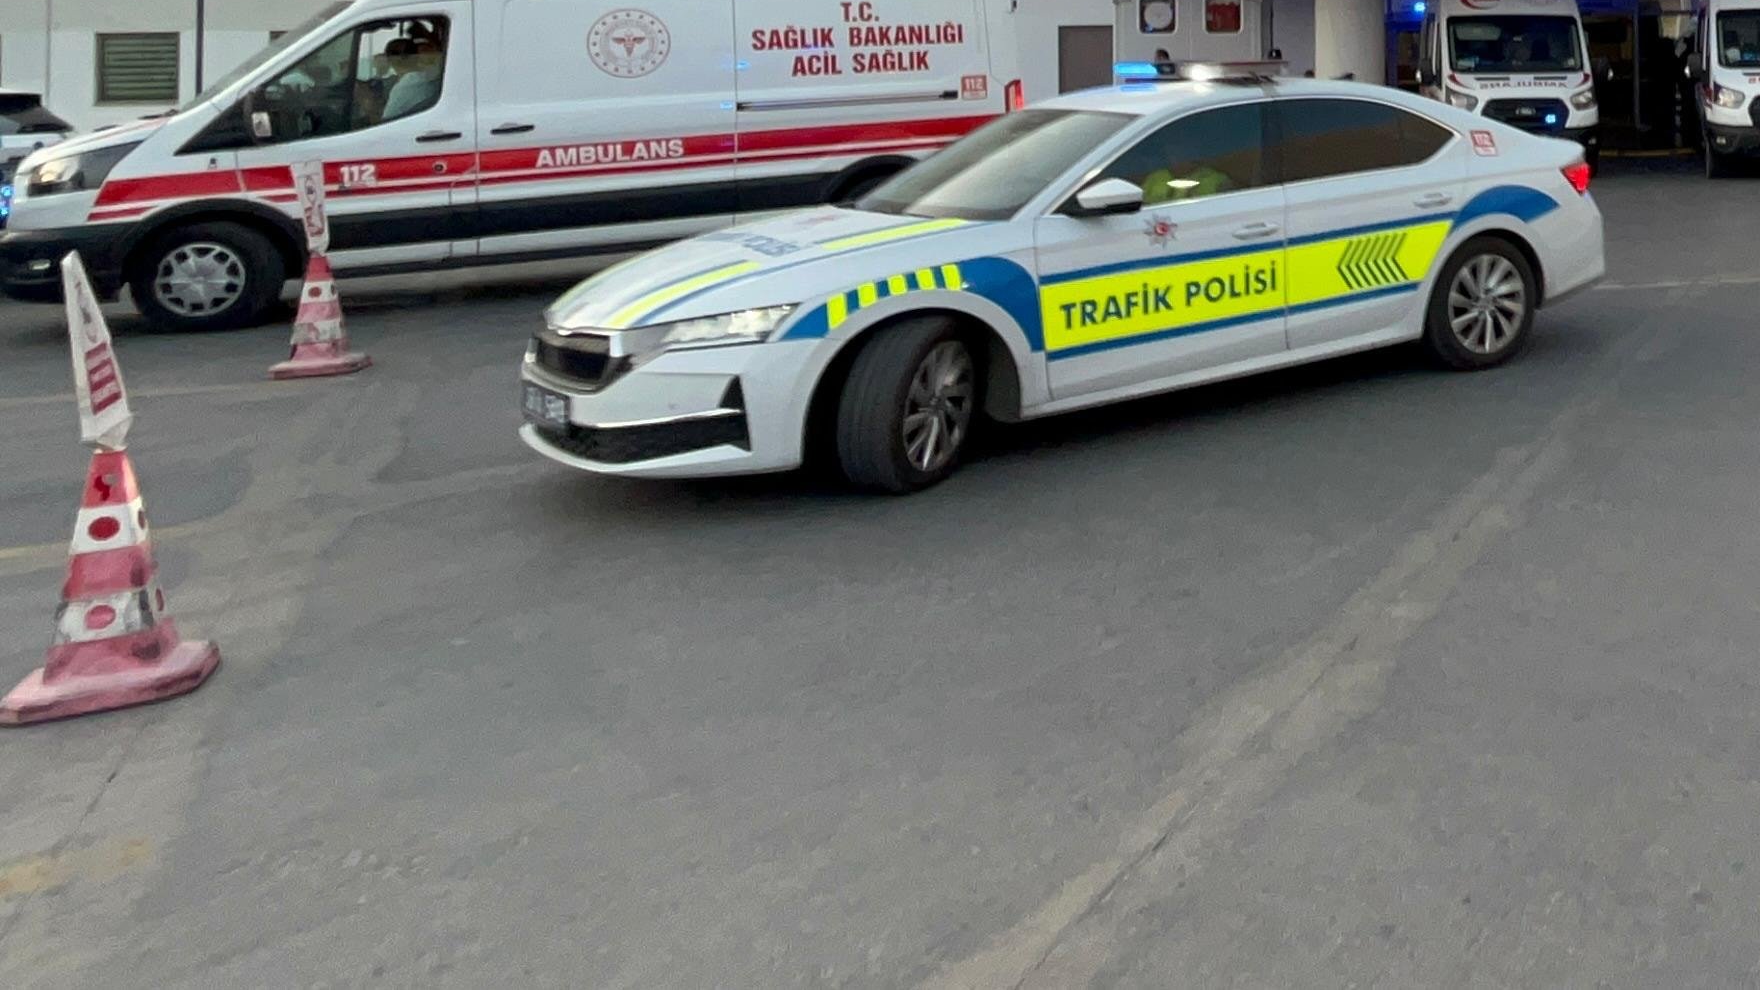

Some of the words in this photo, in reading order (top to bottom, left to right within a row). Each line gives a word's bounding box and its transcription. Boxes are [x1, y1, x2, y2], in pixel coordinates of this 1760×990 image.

[840, 1, 880, 23] T.C.
[751, 25, 835, 51] SAĞLIK
[848, 21, 964, 48] BAKANLIĞI
[791, 50, 843, 77] ACİL
[852, 49, 930, 74] SAĞLIK
[964, 78, 984, 90] 112
[536, 139, 685, 168] AMBULANS
[339, 163, 377, 186] 112
[1059, 282, 1174, 330] TRAFİK
[1185, 260, 1277, 307] POLİSİ
